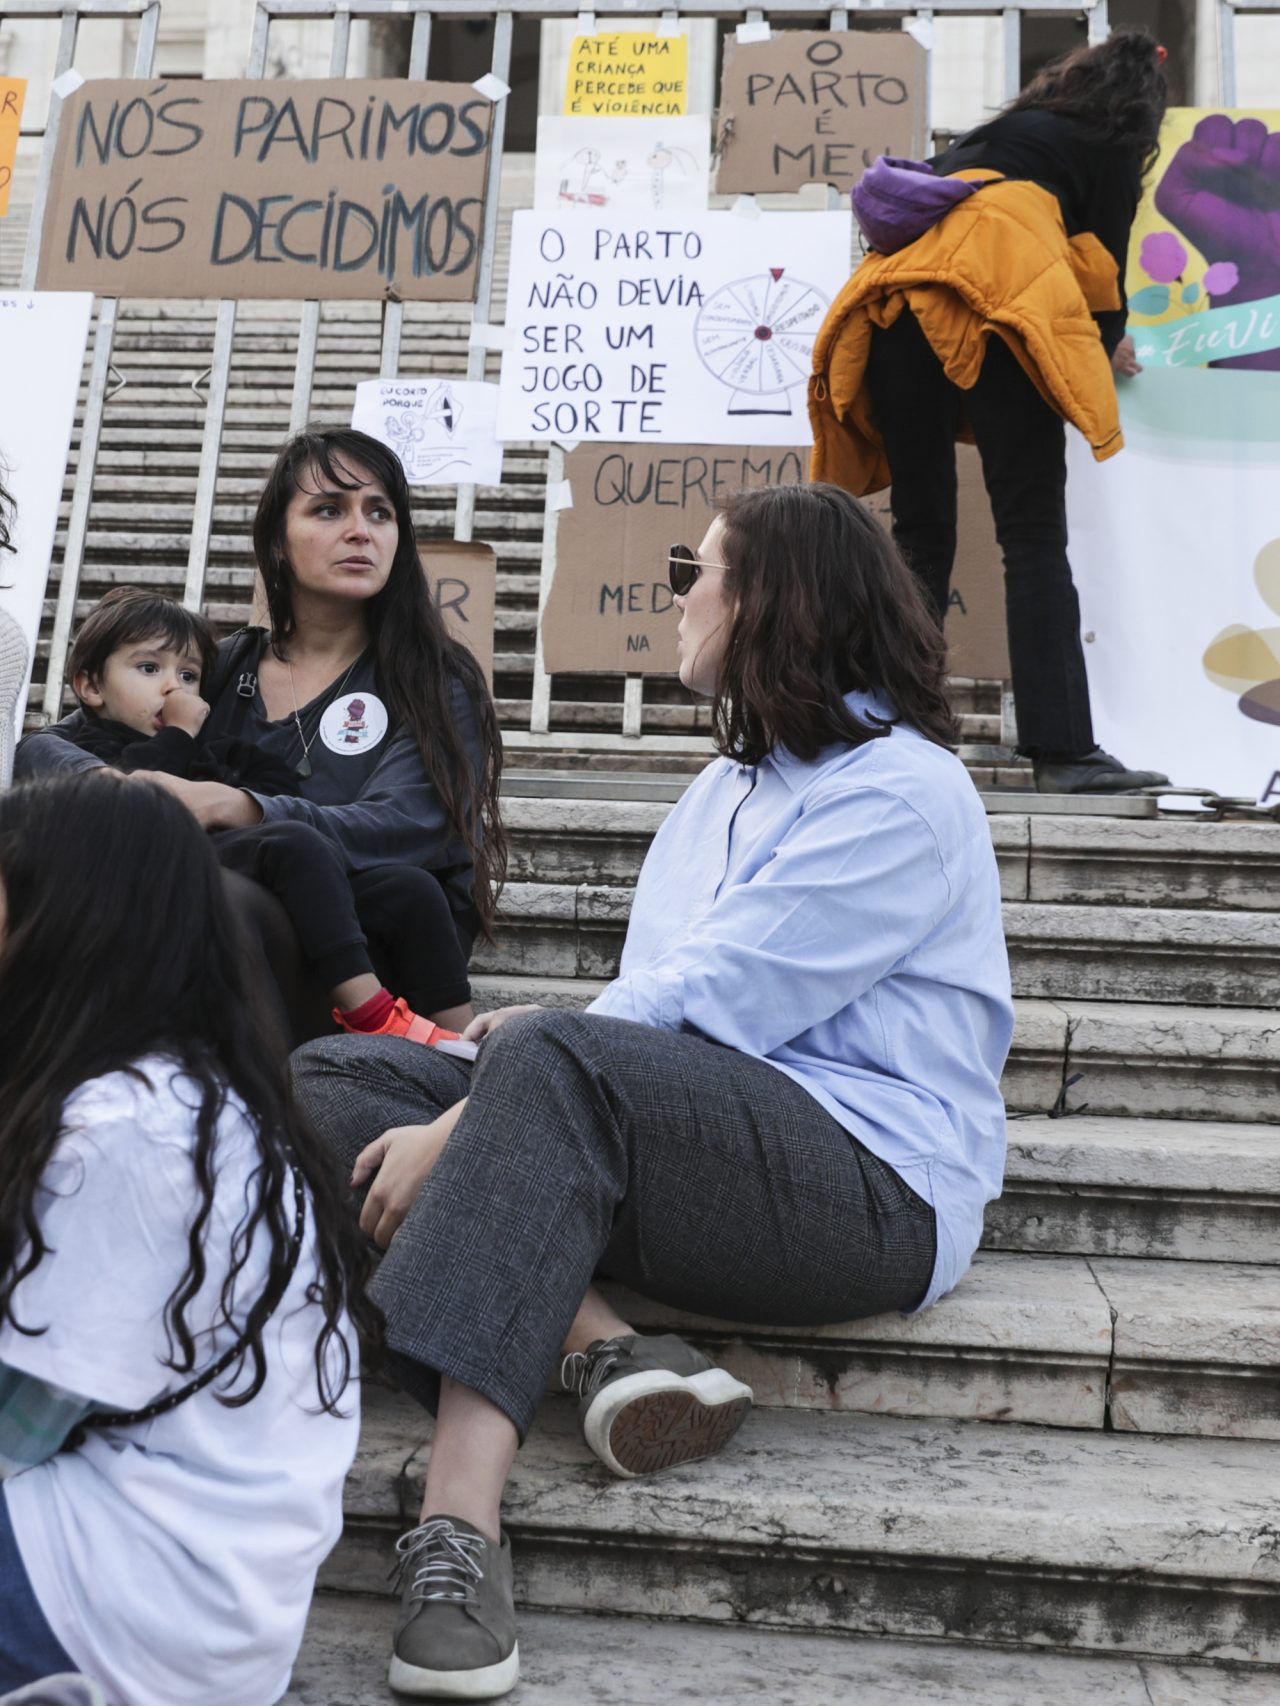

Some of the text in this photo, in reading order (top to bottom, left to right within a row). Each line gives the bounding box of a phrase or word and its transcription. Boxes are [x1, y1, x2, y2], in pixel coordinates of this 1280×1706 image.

[578, 36, 670, 56] ATÉ UMA
[806, 40, 843, 66] O
[576, 61, 646, 79] CRIANÇA
[574, 80, 683, 95] PERCEBE QUE
[746, 70, 909, 108] PARTO
[571, 97, 682, 115] É VIOLÊNCIA
[75, 84, 205, 168] NÓS
[816, 108, 837, 135] É
[65, 178, 190, 263] NÓS
[540, 228, 702, 262] O PARTO
[528, 273, 597, 309] NÃO
[618, 275, 704, 307] DEVIA
[523, 324, 654, 353] SER UM
[522, 363, 667, 393] JOGO DE
[531, 400, 663, 434] SORTE
[599, 582, 676, 615] MED
